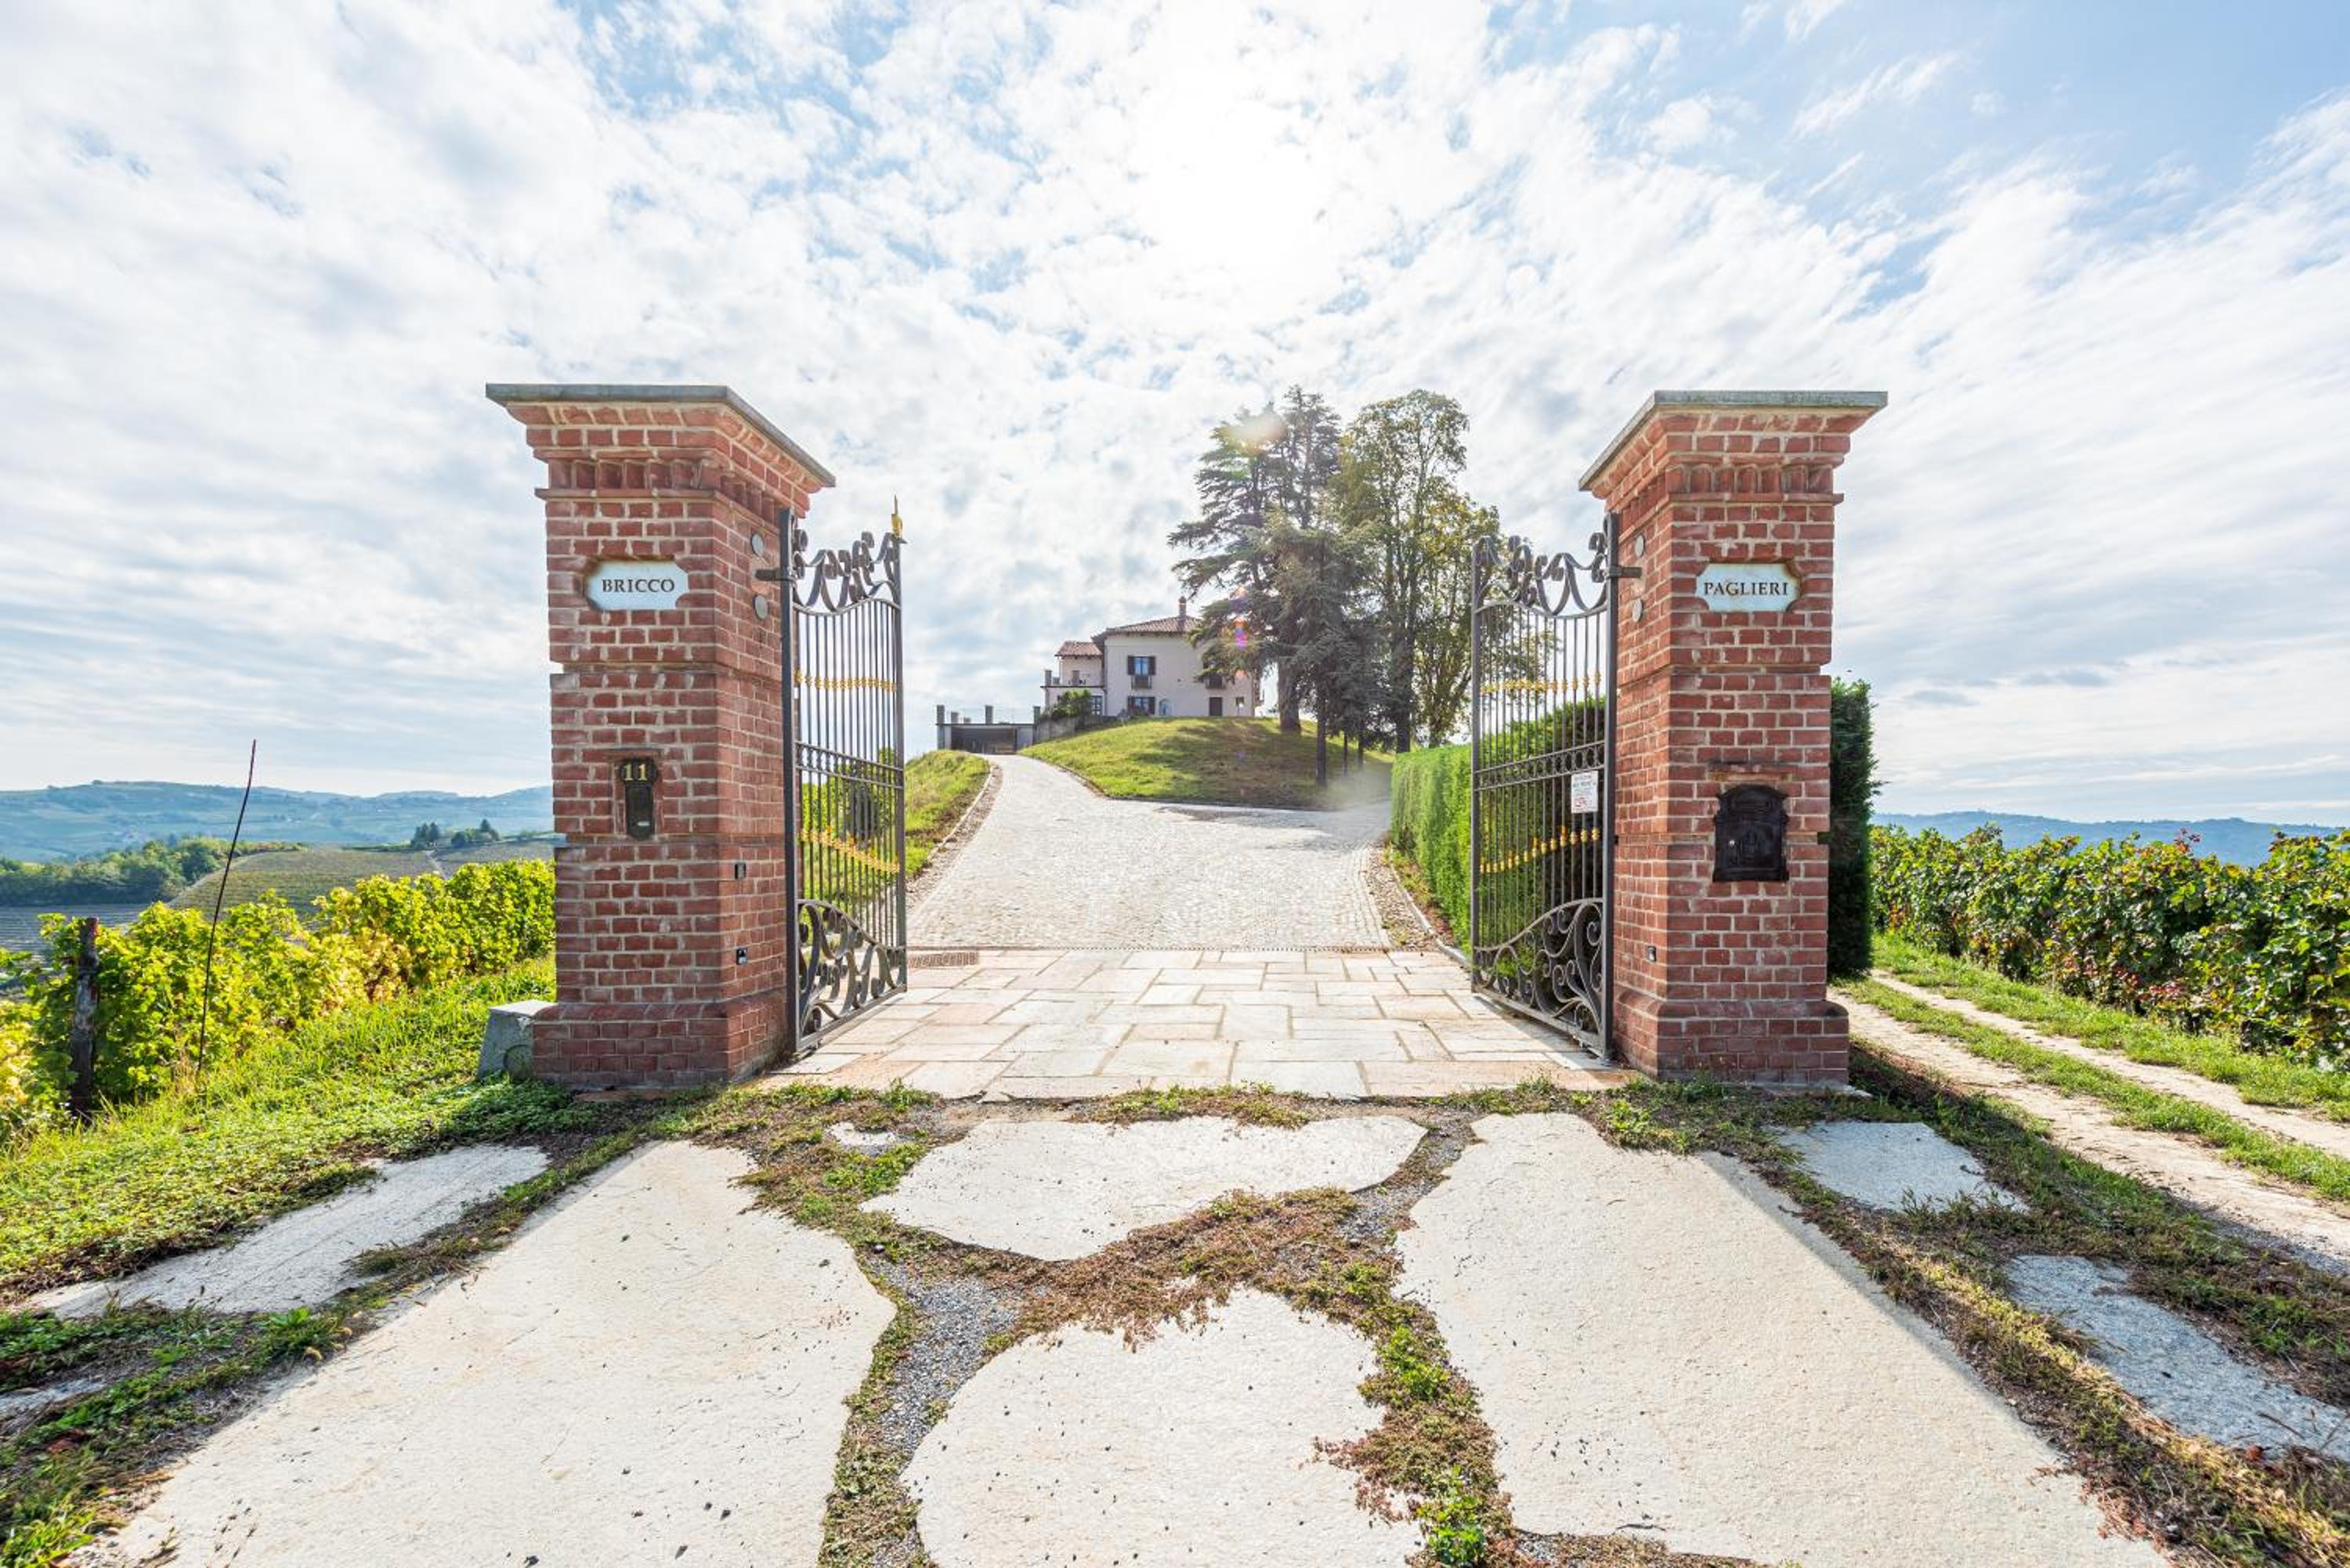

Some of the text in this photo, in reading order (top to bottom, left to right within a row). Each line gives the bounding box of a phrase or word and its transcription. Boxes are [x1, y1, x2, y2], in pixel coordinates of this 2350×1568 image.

[601, 578, 675, 593] BRICCO
[1704, 582, 1789, 596] PAGLIERI
[623, 764, 648, 781] 11
